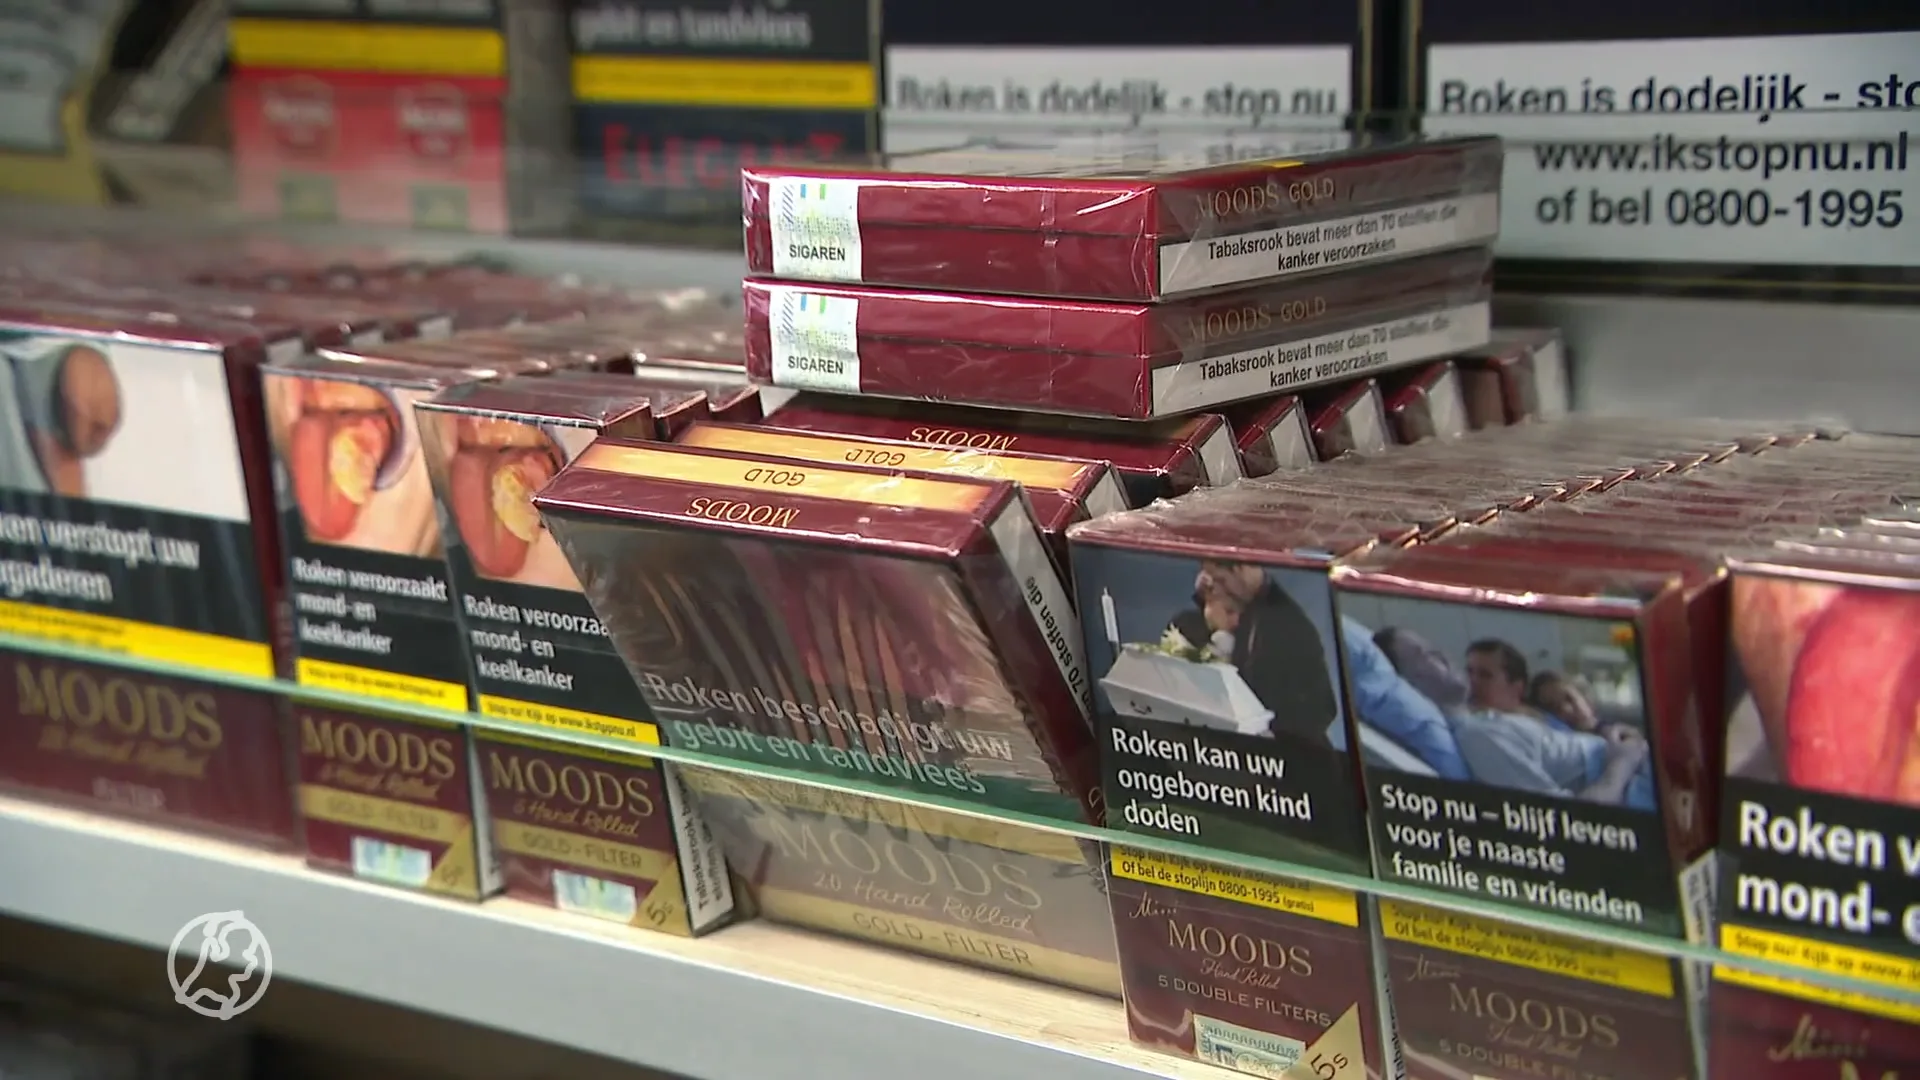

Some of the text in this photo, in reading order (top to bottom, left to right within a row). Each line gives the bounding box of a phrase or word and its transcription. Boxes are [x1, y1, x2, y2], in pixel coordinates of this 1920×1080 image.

[1040, 78, 1167, 127] dodelijk
[1203, 83, 1280, 127] stop
[1291, 87, 1338, 114] nu
[1440, 79, 1567, 114] Roken
[1581, 78, 1615, 113] is
[1631, 73, 1806, 124] dodelijk
[1533, 131, 1909, 180] www.ikstopnu.nl
[1195, 177, 1336, 221] MOODS GOLD
[1536, 188, 1905, 229] of bel 0800-1995
[789, 244, 846, 262] SIGAREN
[1208, 233, 1284, 260] Tabaksrook
[1286, 231, 1321, 250] bevat
[1323, 225, 1353, 243] meer
[1355, 215, 1380, 235] dan
[1381, 213, 1396, 232] 70
[1278, 238, 1396, 271] kanker veroorzaken
[1188, 296, 1327, 344] MOODS GOLD
[787, 355, 844, 374] SIGAREN
[1199, 353, 1275, 381] Tabaksrook
[1277, 344, 1312, 364] bevat
[1314, 337, 1344, 357] meer
[1346, 330, 1371, 348] dan
[1372, 327, 1388, 344] 70
[1270, 350, 1388, 388] kanker veroorzaken
[845, 448, 906, 467] GOLD
[906, 427, 1018, 450] MOODS
[744, 468, 805, 487] GOLD
[685, 497, 800, 529] MOODS
[43, 519, 155, 569] verstopt
[154, 536, 200, 571] uw
[292, 556, 449, 603] Roken veroorzaakt
[353, 600, 377, 623] en
[463, 593, 522, 624] Roken
[299, 617, 393, 655] keelkanker
[469, 628, 555, 659] mond- en
[1039, 605, 1073, 668] stoffen
[475, 652, 575, 691] keelkanker
[1067, 667, 1083, 694] 70
[15, 661, 223, 750] MOODS
[645, 672, 1013, 761] Roken beschadigt uw
[301, 714, 456, 780] MOODS
[673, 717, 987, 795] gebit en tandvlees
[1111, 726, 1285, 780] Roken kan uw
[489, 751, 655, 817] MOODS
[1118, 767, 1251, 811] ongeboren
[1256, 784, 1312, 821] kind
[583, 812, 639, 838] Rolled
[1124, 798, 1200, 836] doden
[1381, 783, 1438, 821] Stop
[1444, 799, 1477, 823] nu
[1503, 800, 1556, 841] blijf
[1562, 811, 1638, 852] leven
[1739, 800, 1886, 871] Roken
[585, 843, 643, 869] FILTER
[768, 816, 1042, 911] MOODS
[1386, 822, 1566, 873] voor je naaste
[1121, 860, 1136, 874] Of
[1137, 864, 1156, 879] bel
[1157, 870, 1173, 883] de
[1174, 873, 1217, 892] stoplijn
[1218, 879, 1281, 904] 0800-1995
[1392, 852, 1643, 923] familie en vrienden
[1737, 873, 1892, 933] mond-
[854, 877, 931, 911] Hand
[943, 895, 1034, 936] Rolled
[853, 910, 924, 942] GOLD
[947, 930, 1033, 967] FILTER
[1167, 918, 1313, 977] MOODS
[1200, 957, 1239, 982] Hand
[1157, 974, 1333, 1027] 5 DOUBLE FILTERS
[1449, 982, 1620, 1048] MOODS
[1310, 1052, 1349, 1080] 5s
[1457, 1042, 1545, 1073] DOUBLE
